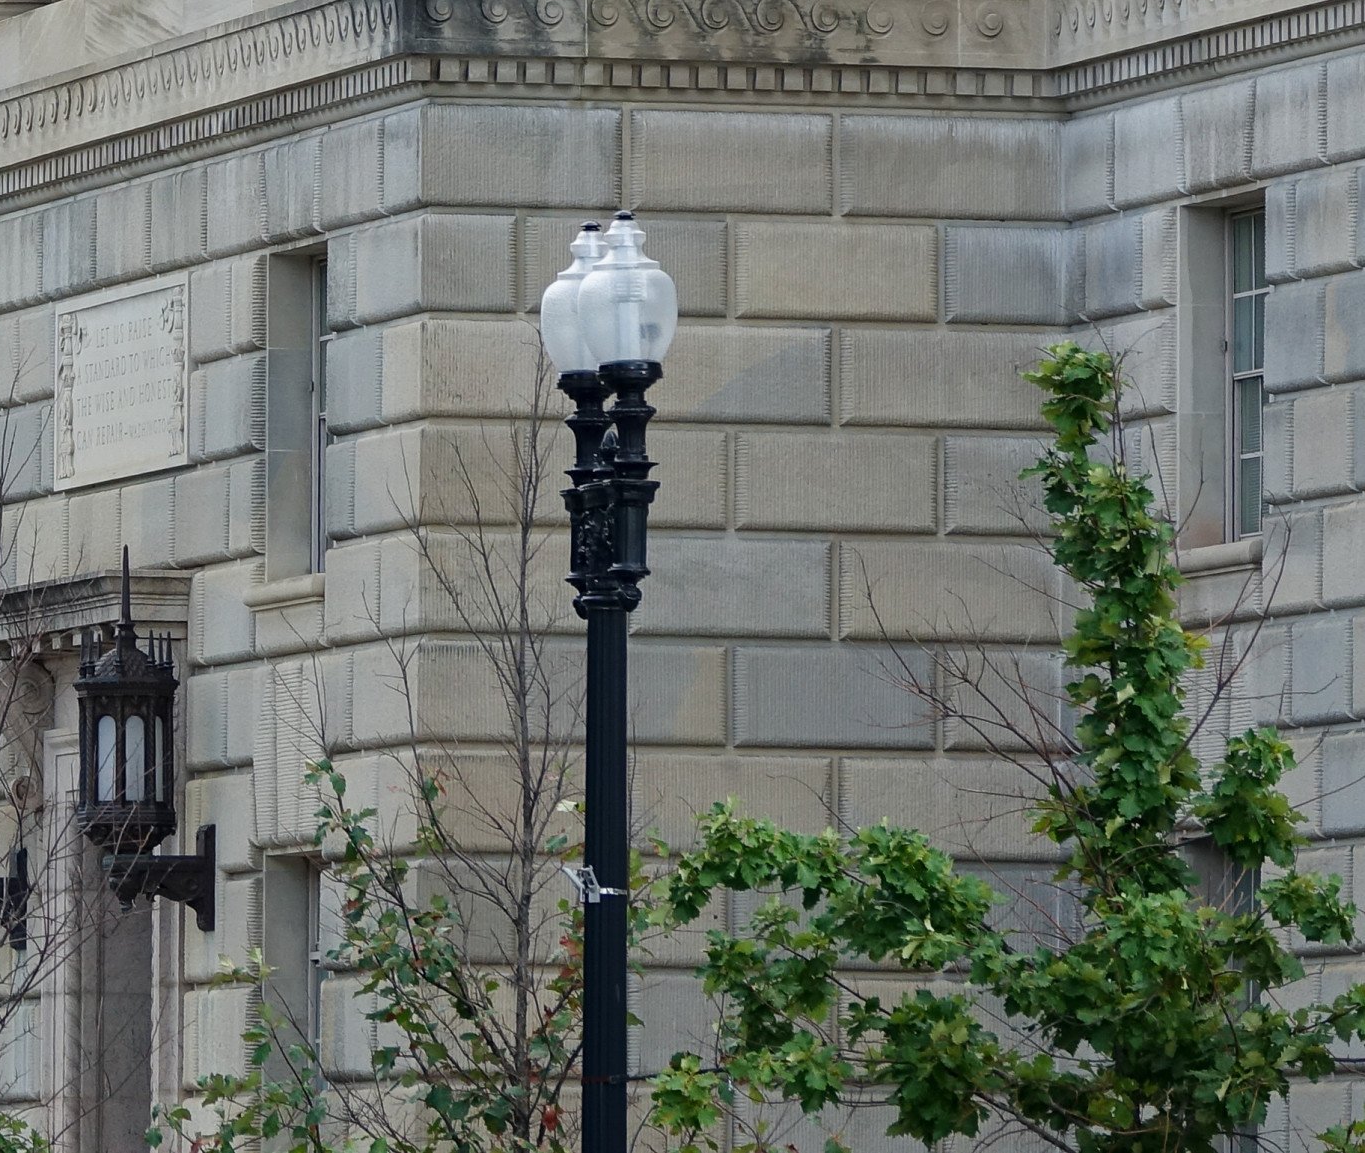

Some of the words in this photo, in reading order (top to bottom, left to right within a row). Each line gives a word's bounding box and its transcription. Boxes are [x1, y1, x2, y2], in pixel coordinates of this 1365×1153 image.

[96, 327, 110, 348] LET
[113, 323, 124, 344] US
[128, 317, 152, 342] RAISE
[85, 355, 126, 384] STANDARD
[128, 352, 139, 374] TO
[76, 396, 92, 417] THE
[94, 391, 114, 413] WISE
[117, 386, 135, 410] AND
[139, 378, 172, 405] HONEST
[76, 429, 93, 450] CAN
